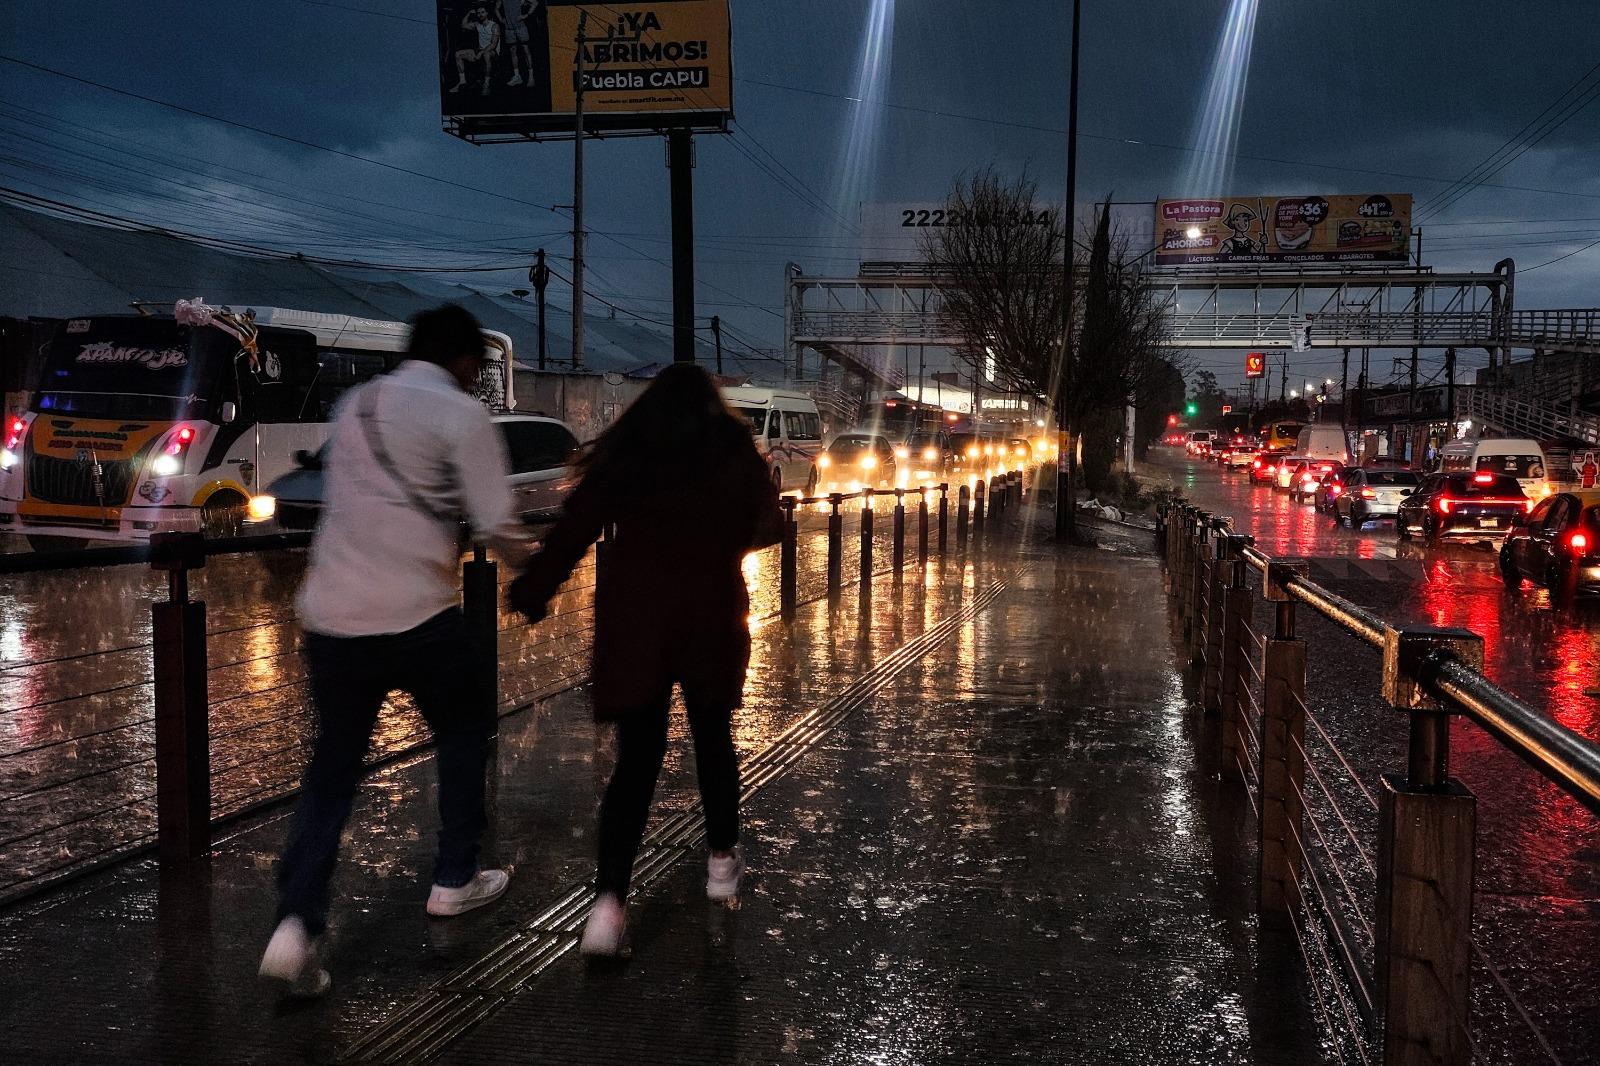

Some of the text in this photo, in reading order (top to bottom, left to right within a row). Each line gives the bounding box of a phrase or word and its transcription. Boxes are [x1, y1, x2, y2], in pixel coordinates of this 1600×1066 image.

[618, 12, 662, 36] ¡YA
[574, 41, 708, 64] ABRIMOS!
[581, 71, 704, 89] Puebla CAPU
[1166, 205, 1221, 215] La Pastora
[1166, 237, 1213, 249] AHORROS!
[1188, 255, 1215, 263] LÁCTEOS
